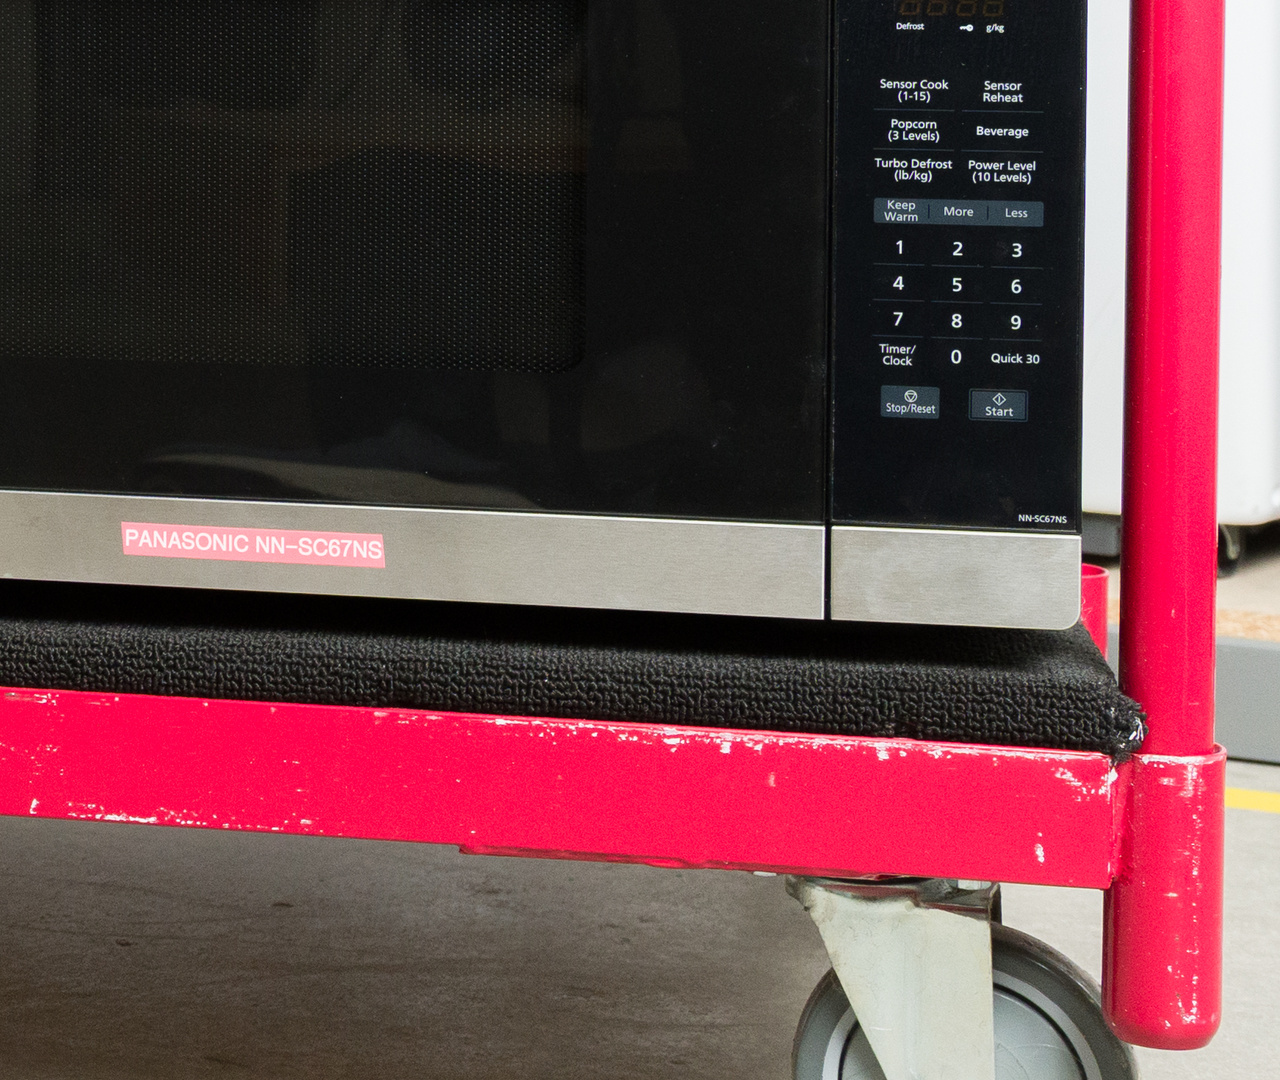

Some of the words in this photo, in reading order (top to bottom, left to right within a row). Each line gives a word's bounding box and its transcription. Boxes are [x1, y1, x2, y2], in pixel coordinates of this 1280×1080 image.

[896, 22, 925, 31] Defrost
[985, 23, 1005, 33] g/kg
[879, 79, 917, 90] Sensor
[919, 79, 949, 90] Cook
[984, 80, 1022, 91] Sensor
[897, 90, 931, 103] (1-15)
[982, 92, 1024, 103] Reheat
[890, 119, 937, 132] Popcorn
[887, 130, 900, 142] (3
[901, 130, 940, 143] Levels)
[975, 126, 1029, 139] Beverage
[874, 157, 908, 169] Turbo
[910, 158, 953, 169] Defrost
[967, 160, 1006, 171] Power
[1008, 160, 1036, 171] Level
[893, 170, 933, 183] (lb/kg)
[972, 172, 991, 184] (10
[993, 172, 1032, 185] Levels)
[886, 200, 916, 213] Keep
[943, 206, 974, 217] More
[1004, 207, 1028, 218] Less
[884, 211, 919, 222] Warm
[895, 239, 904, 255] 1
[952, 241, 963, 256] 2
[1011, 243, 1022, 258] 3
[892, 275, 904, 290] 4
[952, 277, 963, 292] 5
[1010, 279, 1022, 294] 6
[892, 311, 903, 326] 7
[951, 313, 962, 328] 8
[1010, 315, 1021, 330] 9
[879, 343, 917, 356] Timer/
[882, 354, 913, 366] Clock
[950, 349, 962, 365] 0
[991, 352, 1024, 366] Quick
[1025, 353, 1040, 366] 30
[885, 402, 936, 415] Stop/Reset
[985, 405, 1014, 418] Start
[1018, 513, 1068, 525] NN-SC67NS
[125, 528, 249, 553] PANASONIC
[255, 535, 383, 560] NN-SC67NS
